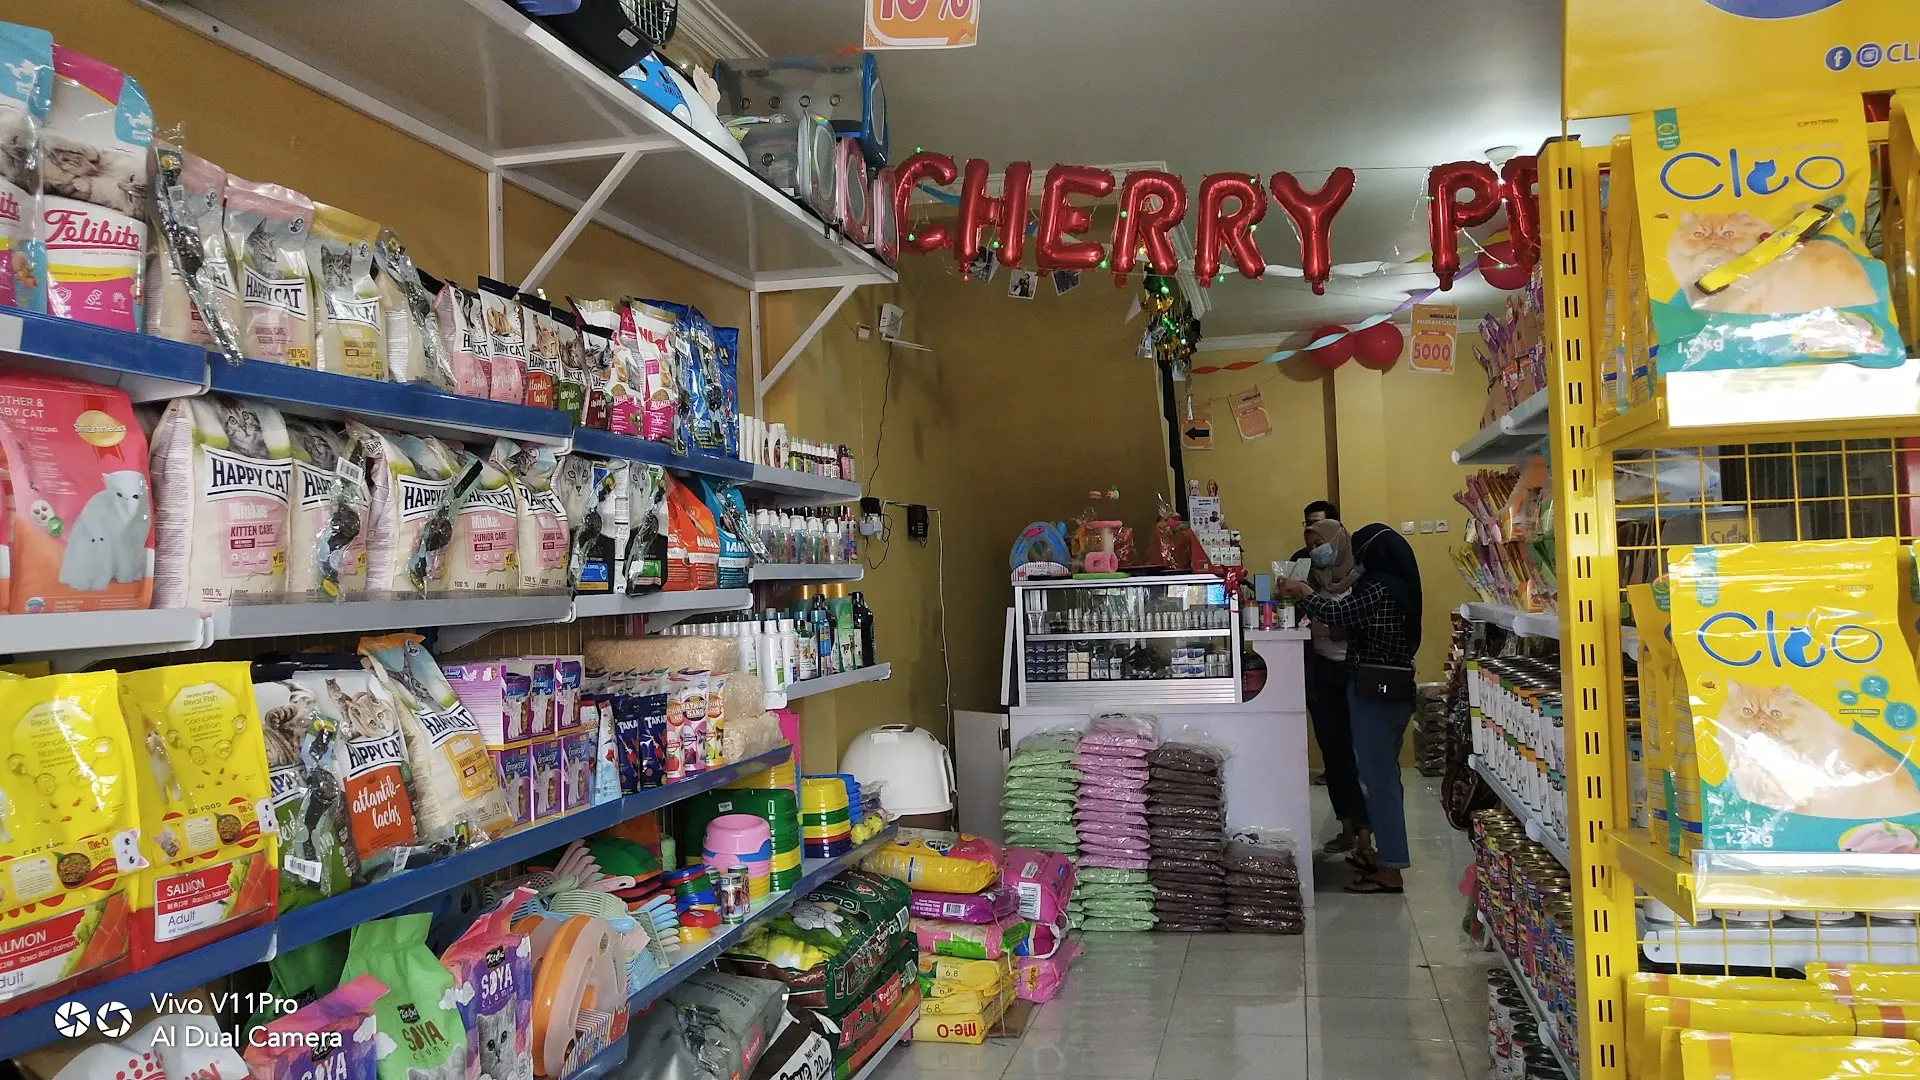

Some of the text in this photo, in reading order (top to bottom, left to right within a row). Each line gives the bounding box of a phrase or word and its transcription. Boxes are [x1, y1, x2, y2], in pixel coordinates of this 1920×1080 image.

[1886, 41, 1920, 64] CL
[1659, 148, 1845, 200] Cleo
[43, 209, 140, 248] Felibite
[895, 151, 1357, 294] CHERRY
[245, 272, 273, 302] HAPPY
[274, 287, 302, 309] CAT
[509, 345, 526, 359] CAT
[1413, 342, 1451, 361] 5000
[0, 395, 45, 408] OTHER &
[0, 408, 44, 419] ABY CAT
[211, 457, 291, 495] HAPPY CAT
[404, 485, 442, 510] HAPPY
[494, 492, 516, 509] CAT
[471, 514, 501, 529] Minkas
[230, 524, 276, 538] KITTEN CARE
[472, 531, 508, 543] JUNIOR CARE
[202, 588, 214, 597] 100
[1697, 609, 1883, 668] Cleo
[183, 698, 202, 706] Real
[681, 701, 707, 711] BATHING
[183, 713, 223, 726] Complete
[687, 709, 705, 718] SAND
[189, 721, 221, 733] Nutrition
[352, 774, 401, 814] atlantik-
[200, 802, 222, 812] FOOD
[371, 801, 401, 830] lachs
[166, 878, 206, 897] SALMON
[168, 911, 196, 928] Adult
[53, 940, 77, 954] Salmon
[480, 961, 516, 1000] SOYA
[945, 969, 959, 978] 6.8
[402, 1020, 446, 1052] SOYA
[814, 1054, 825, 1077] 20
